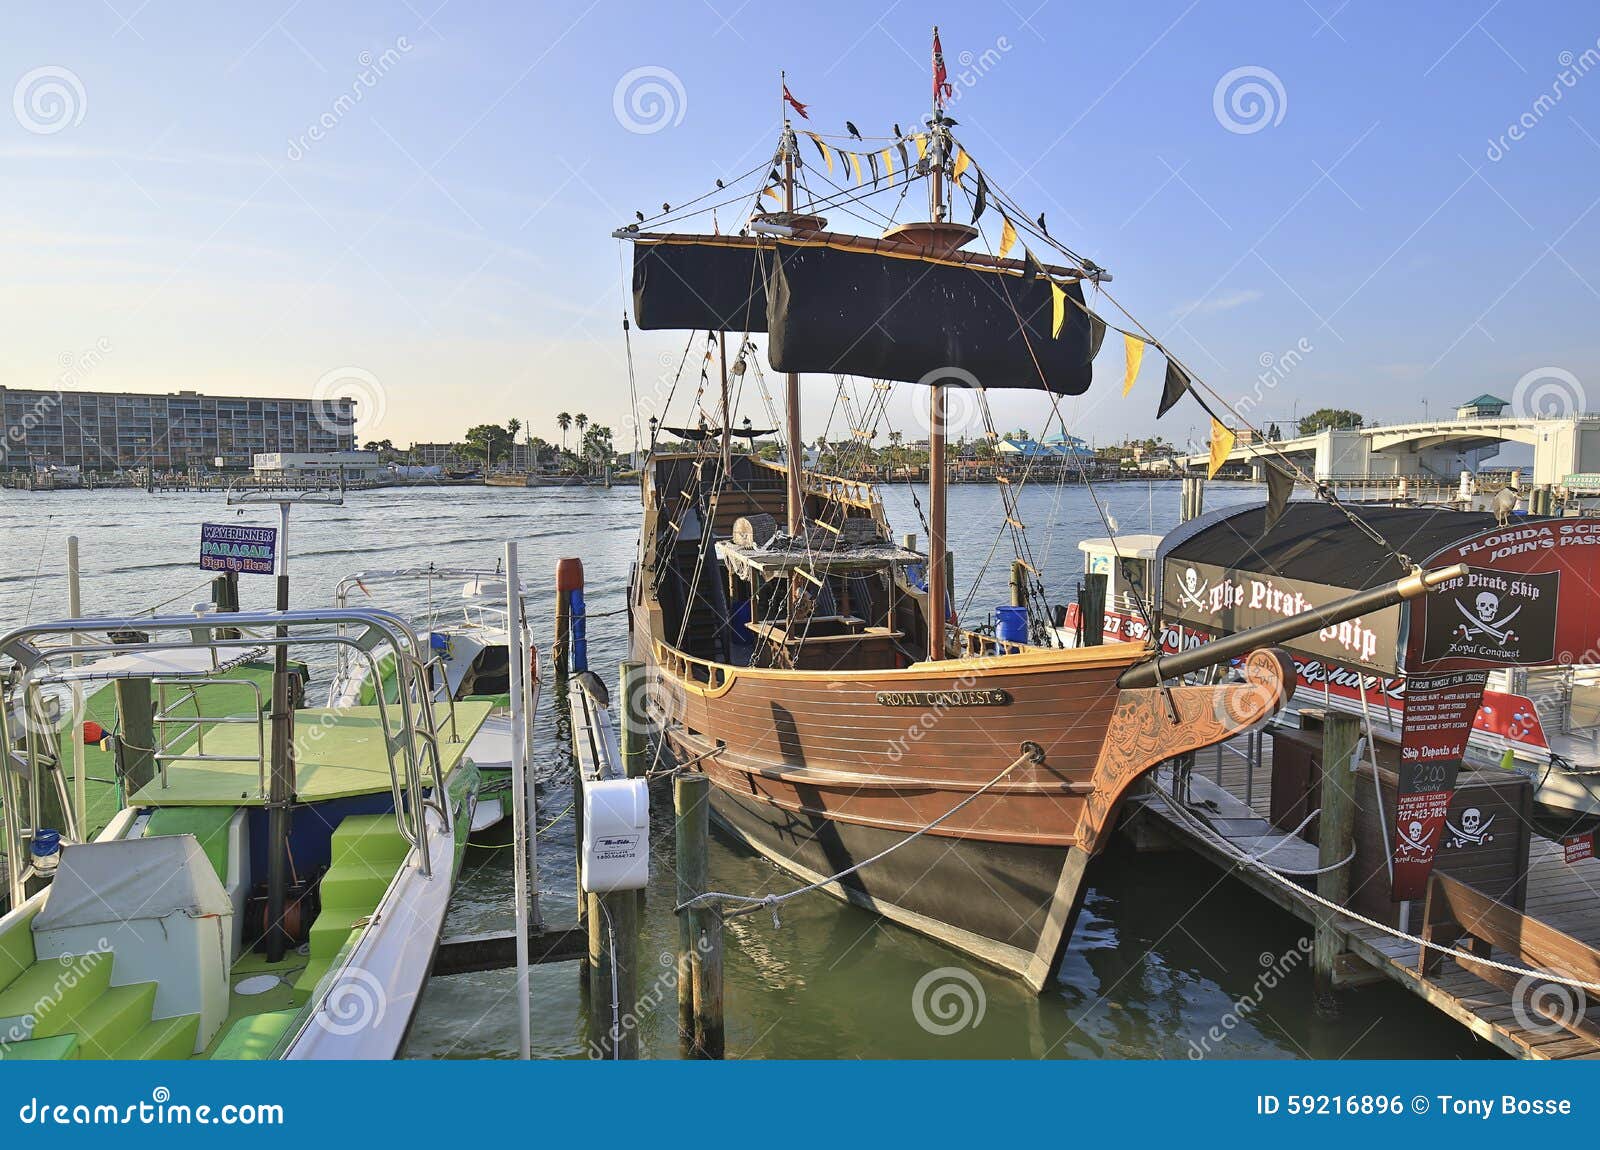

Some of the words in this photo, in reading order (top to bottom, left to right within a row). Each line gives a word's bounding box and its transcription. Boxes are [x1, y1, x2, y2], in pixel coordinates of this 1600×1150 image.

[202, 541, 273, 559] PARASAIL
[1458, 527, 1553, 556] FLORIDA
[1489, 538, 1555, 563] JOHN'S
[1560, 535, 1600, 546] PAS
[202, 555, 226, 569] Sign
[226, 557, 242, 571] Up
[244, 559, 272, 571] Here!
[1467, 573, 1508, 592] Pirate
[1510, 579, 1540, 601] Ship
[1209, 578, 1245, 614] The
[1449, 643, 1479, 655] Royal
[1479, 645, 1520, 658] Conquest
[1415, 681, 1429, 689] HOUR
[1431, 677, 1449, 688] FAMILY
[1452, 675, 1464, 684] FUN
[1465, 673, 1485, 682] CRUISE
[886, 692, 921, 706] ROYAL
[927, 691, 992, 706] CONQUEST
[1402, 747, 1419, 760] Ship
[1421, 745, 1450, 759] Departs
[1451, 743, 1460, 755] at
